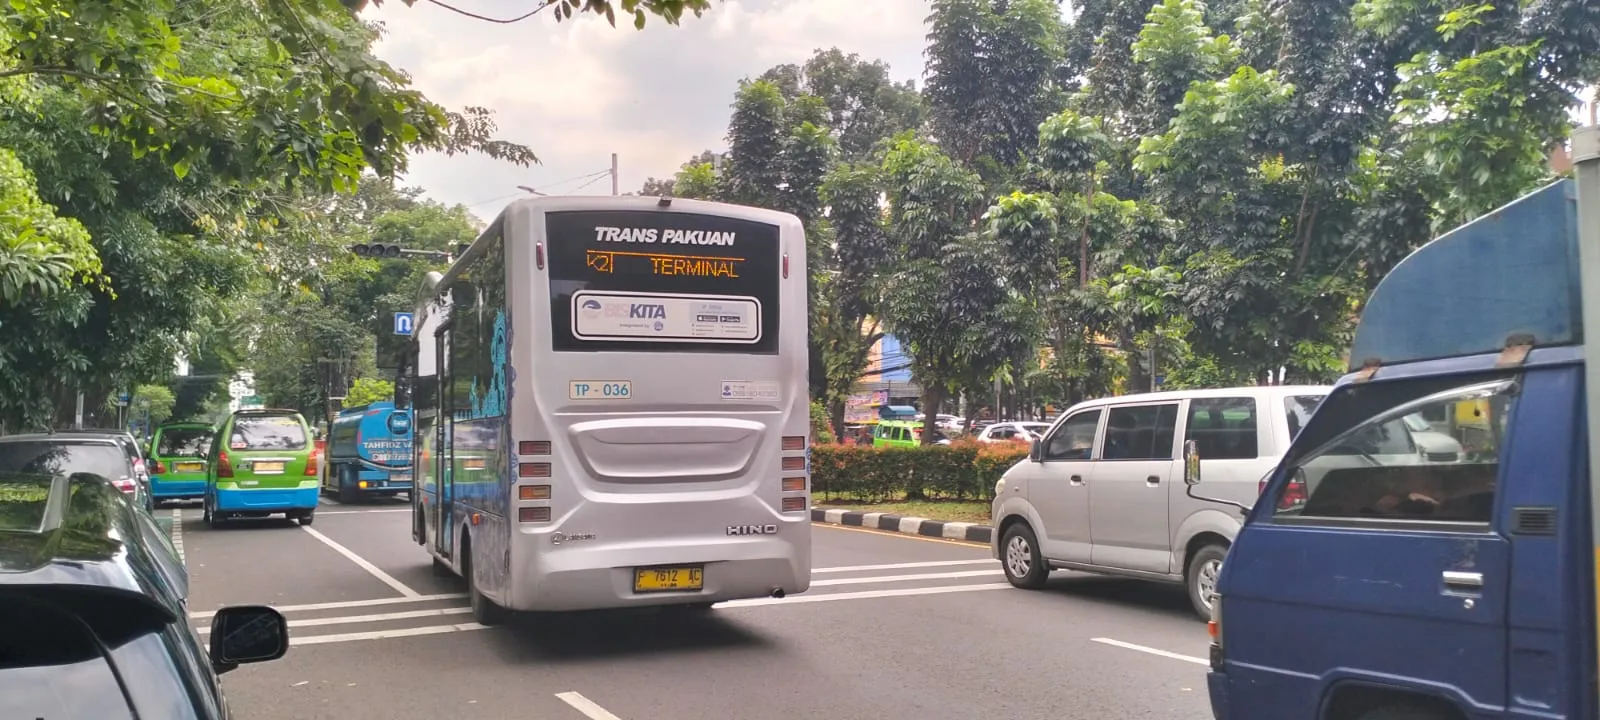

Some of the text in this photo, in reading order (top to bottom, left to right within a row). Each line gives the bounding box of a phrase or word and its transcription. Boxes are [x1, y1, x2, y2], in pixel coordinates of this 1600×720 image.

[595, 226, 735, 246] TRANS PAKUAN
[651, 257, 739, 278] TERMINAL
[575, 384, 590, 396] TP
[603, 384, 629, 396] 036
[726, 524, 778, 536] HINO
[638, 568, 700, 583] F 7612 AC
